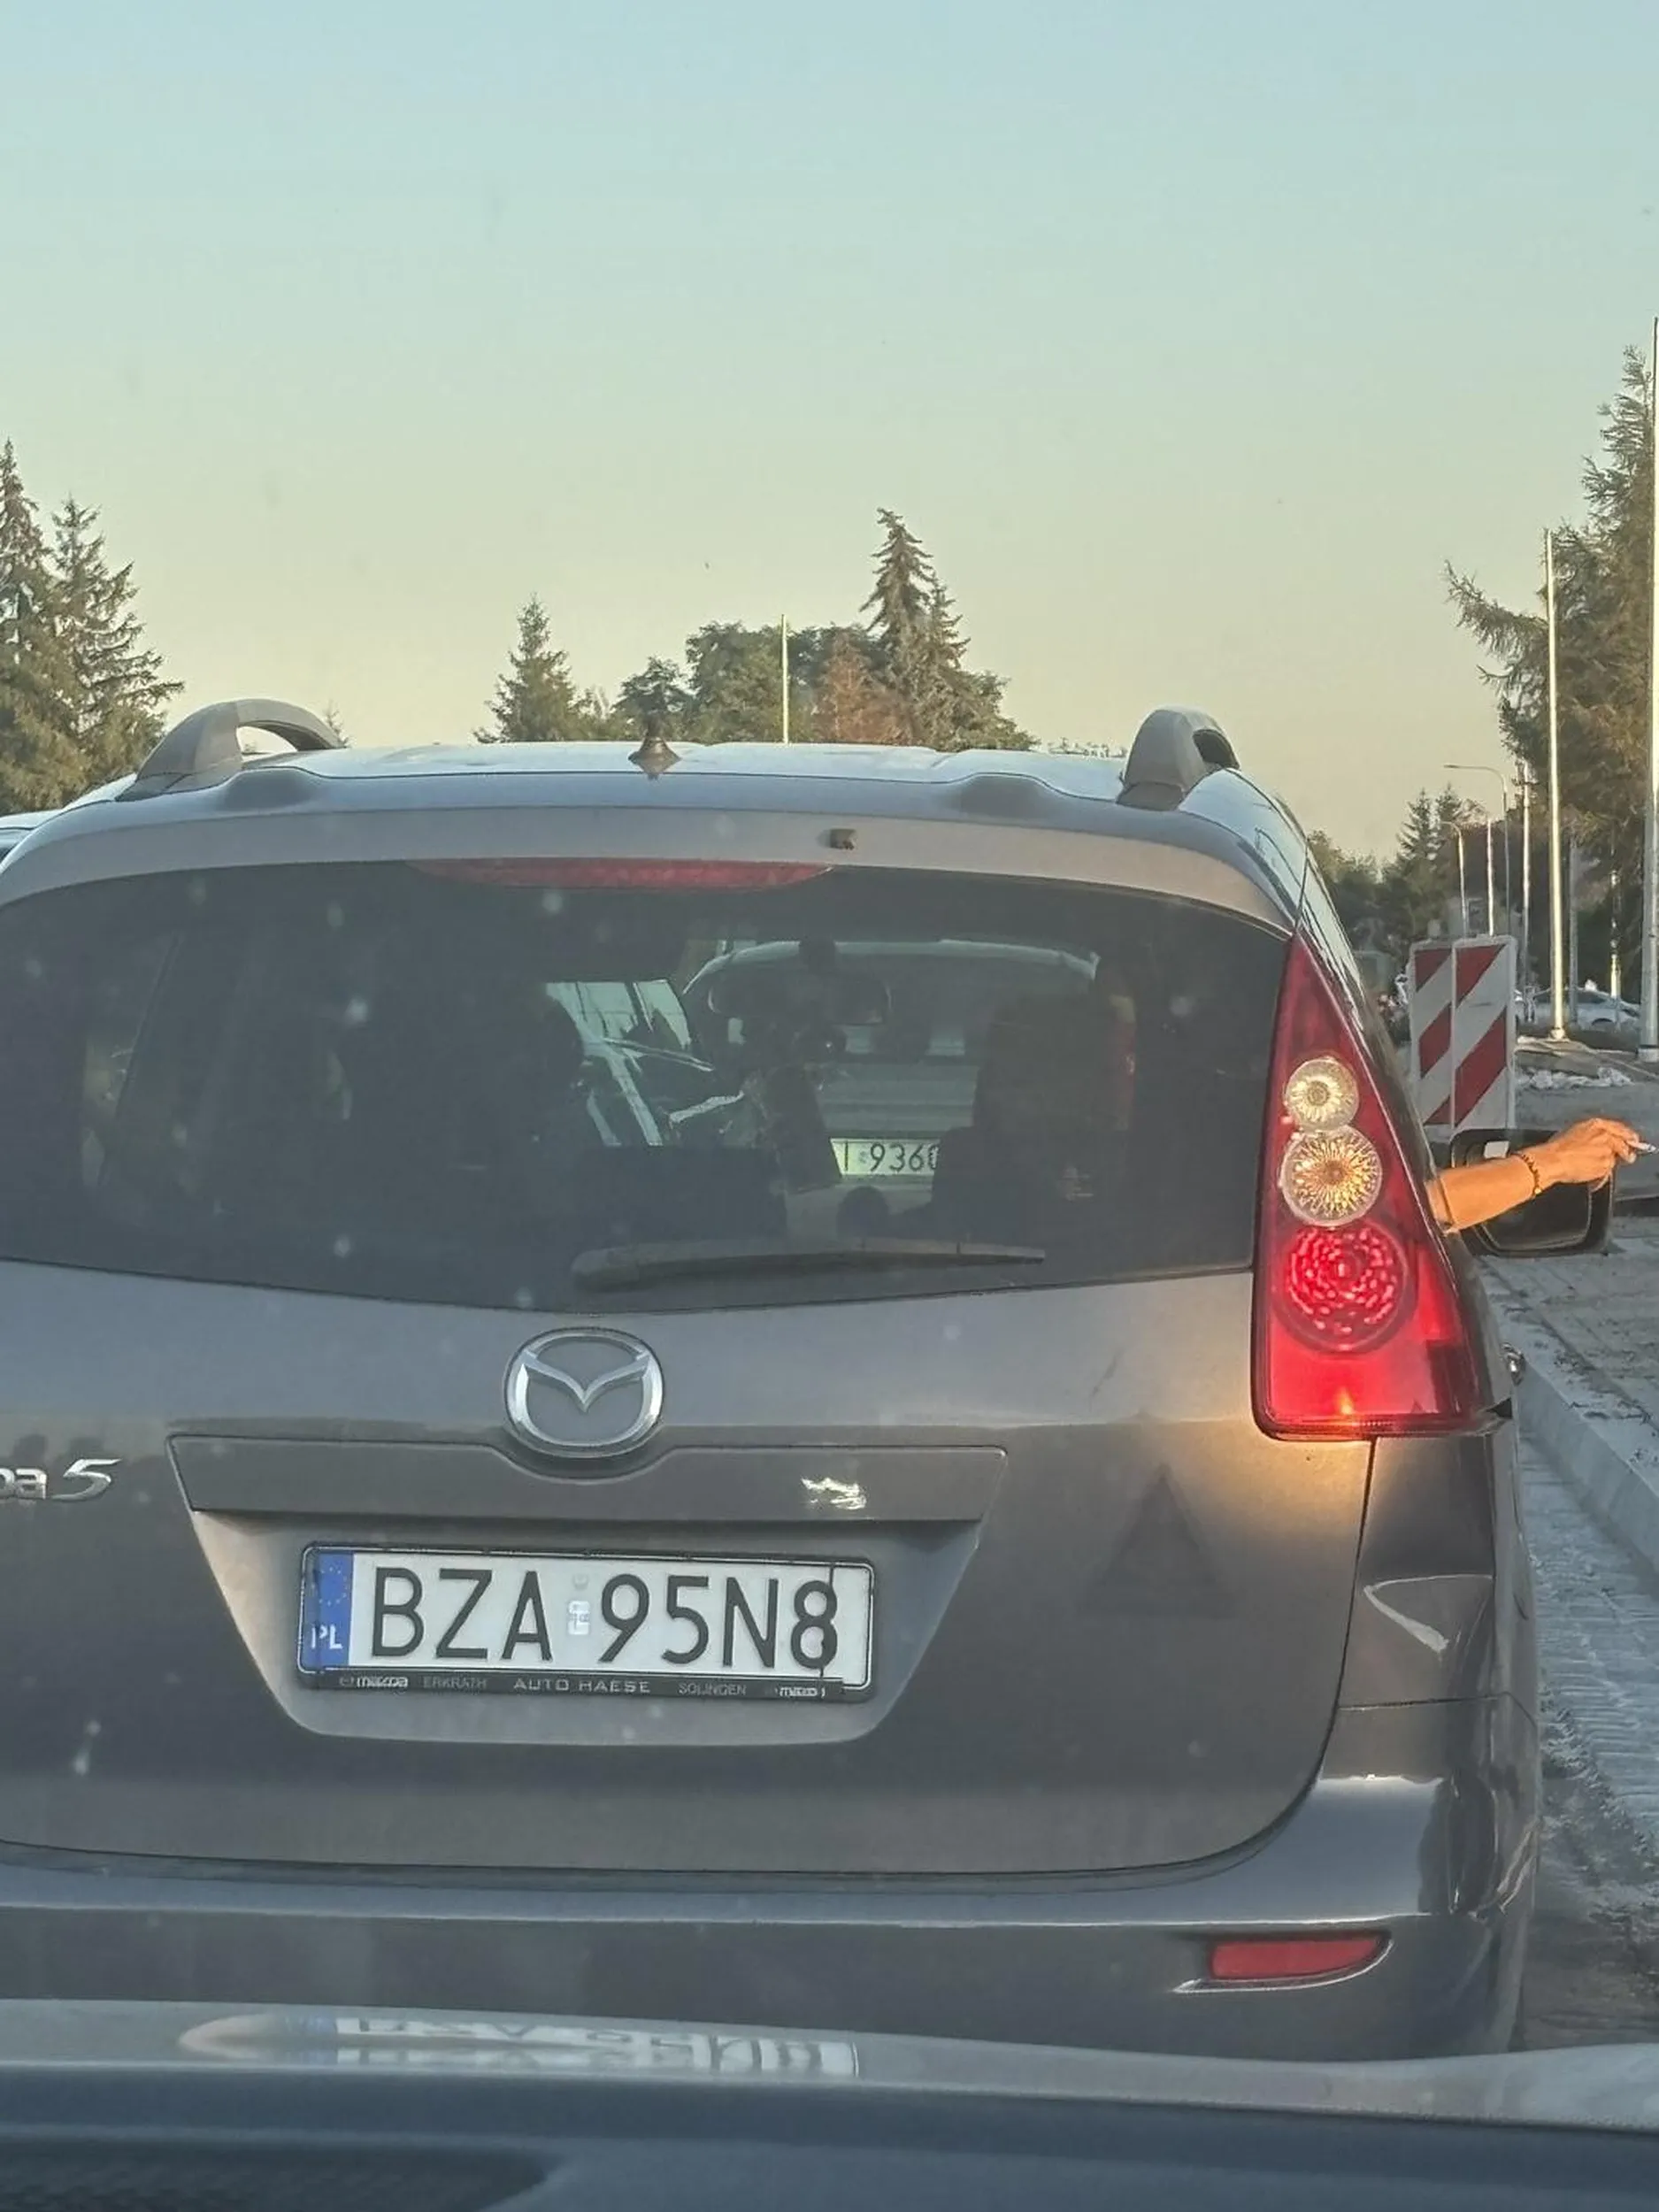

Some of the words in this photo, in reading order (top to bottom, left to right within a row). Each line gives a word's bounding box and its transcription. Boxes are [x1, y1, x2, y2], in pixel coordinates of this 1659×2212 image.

[51, 1458, 123, 1502] 5
[371, 1566, 554, 1662] BZA
[597, 1573, 840, 1671] 95N8
[311, 1624, 342, 1650] PL
[513, 1678, 570, 1691] AUTO
[579, 1680, 651, 1694] HAESE
[678, 1682, 748, 1696] SOLINGEN
